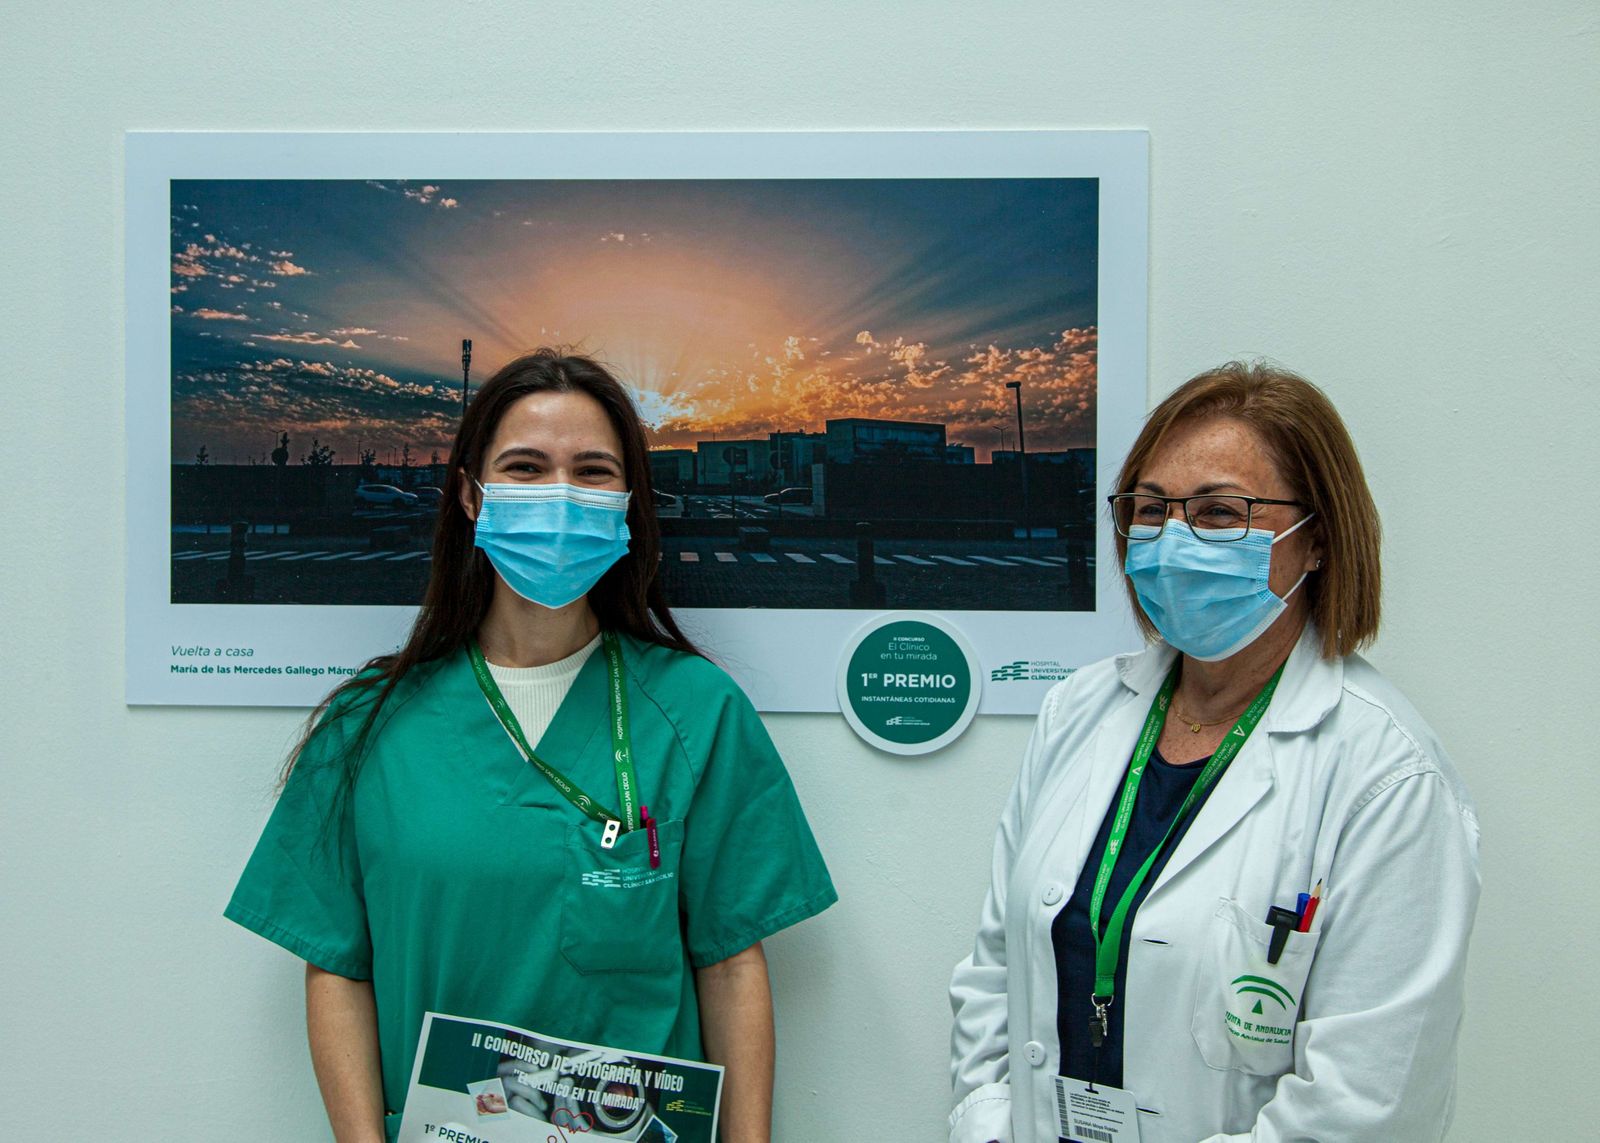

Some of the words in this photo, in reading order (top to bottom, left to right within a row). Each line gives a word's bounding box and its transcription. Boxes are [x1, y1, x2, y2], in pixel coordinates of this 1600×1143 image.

[171, 646, 210, 656] Vuelta
[214, 648, 222, 656] a
[226, 648, 254, 657] casa
[888, 642, 896, 650] El
[900, 642, 930, 651] Clínico
[906, 652, 938, 660] mirada
[170, 664, 198, 674] María
[201, 665, 214, 674] de
[217, 666, 231, 674] las
[234, 666, 282, 674] Mercedes
[285, 666, 325, 676] Gallego
[328, 666, 360, 676] Márqu
[884, 674, 956, 688] PREMIO
[544, 769, 554, 778] SAN
[554, 776, 570, 792] CECILIO
[622, 772, 630, 790] CECILIO
[1244, 1022, 1252, 1031] DE
[472, 1032, 482, 1048] II
[484, 1035, 550, 1068] CONCURSO
[551, 1054, 570, 1072] DE
[571, 1060, 641, 1086] FOTOGRAFÍA
[644, 1070, 653, 1087] Y
[654, 1070, 684, 1092] VÍDEO
[572, 1087, 585, 1102] EN
[588, 1090, 600, 1104] TU
[602, 1092, 645, 1110] MIRADA"
[424, 1124, 436, 1134] 1º
